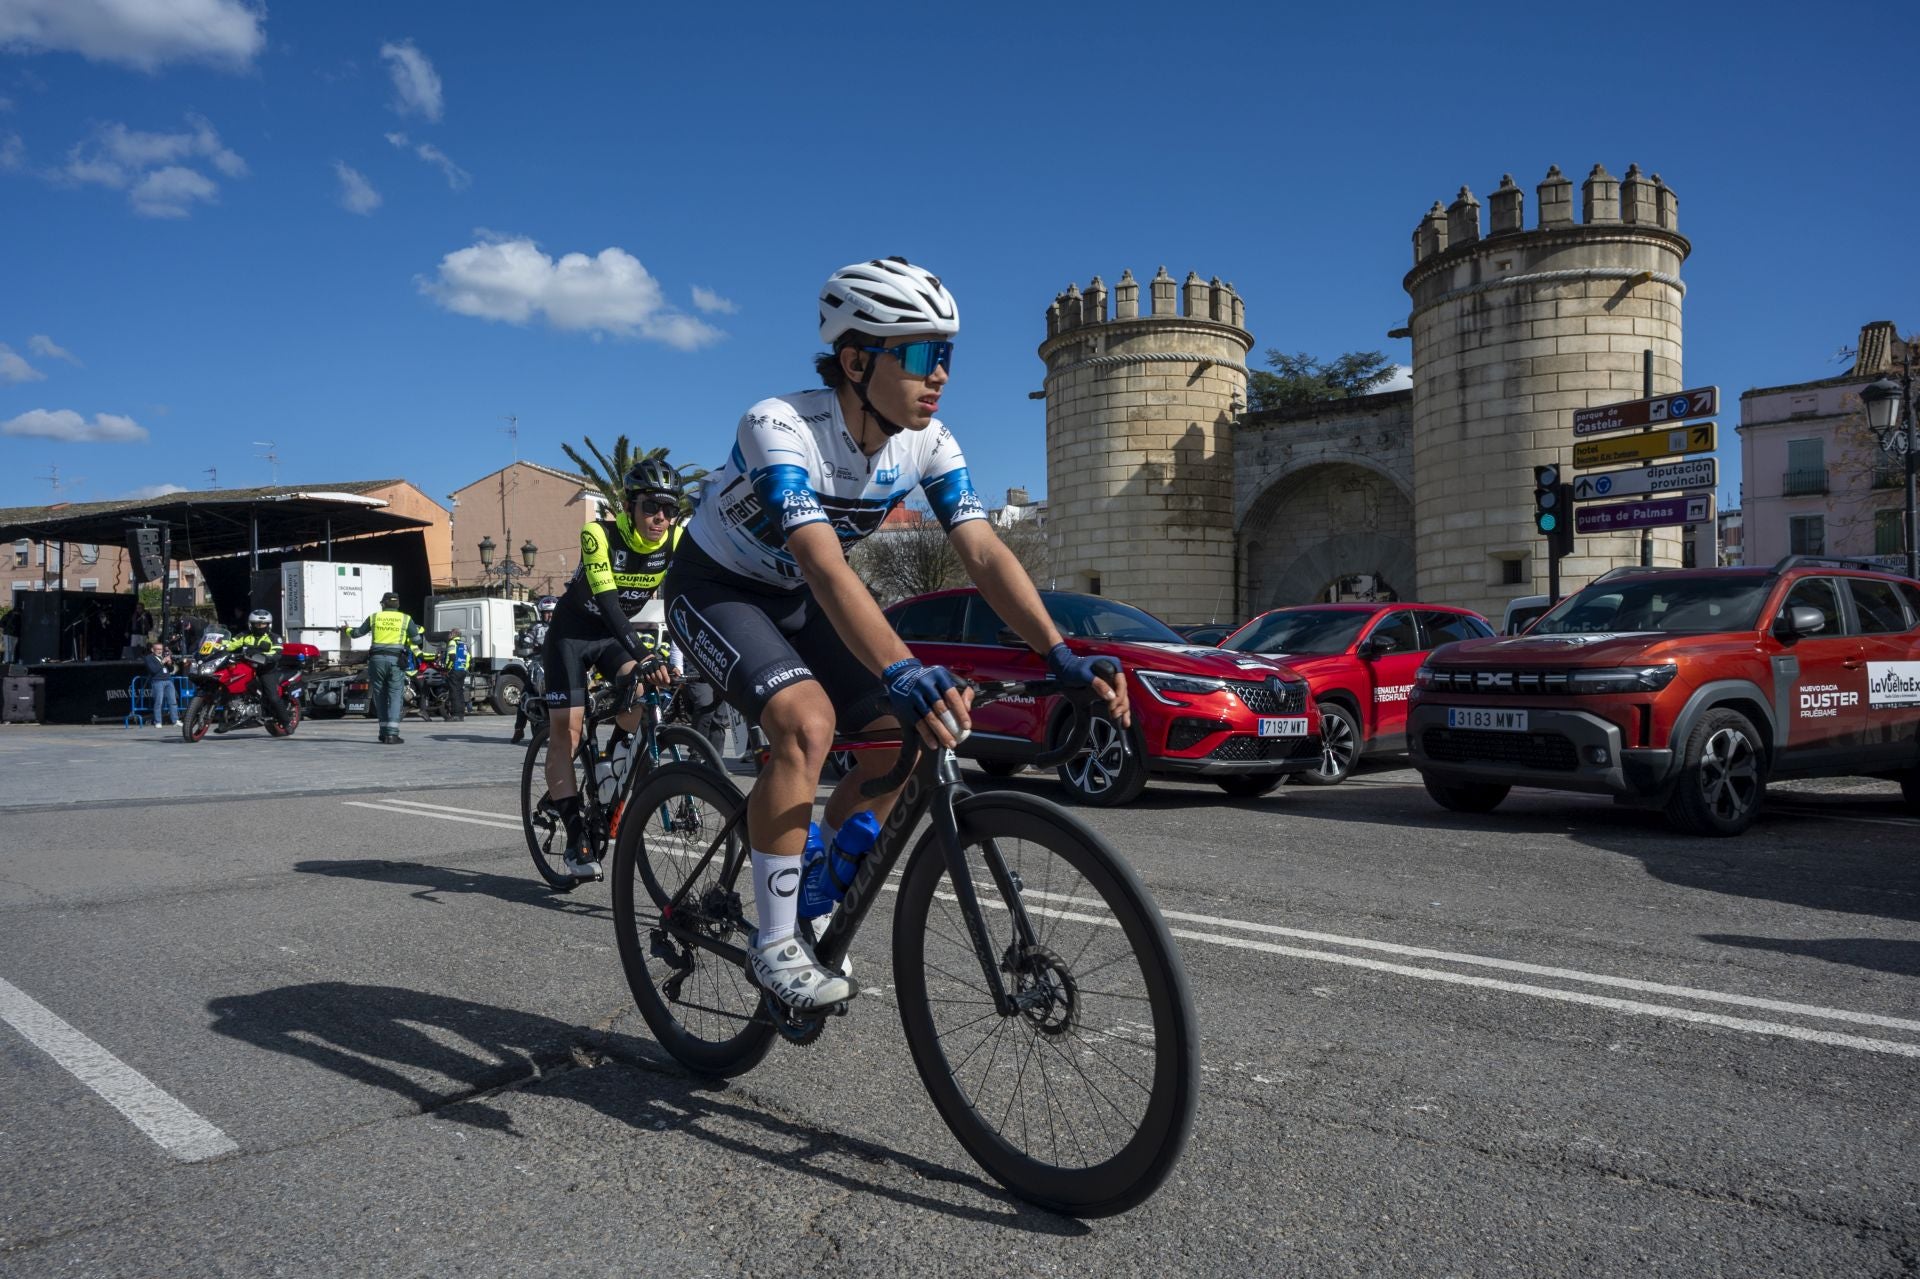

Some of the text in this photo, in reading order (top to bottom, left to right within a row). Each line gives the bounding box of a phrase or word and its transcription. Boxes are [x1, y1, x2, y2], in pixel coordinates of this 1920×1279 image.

[1577, 408, 1618, 422] parque de
[1577, 419, 1623, 433] Castelar
[1577, 445, 1598, 456] hotel
[1651, 473, 1711, 490] provincial
[1579, 506, 1674, 525] puerta de Palmas
[696, 630, 728, 668] Ricardo
[694, 642, 724, 681] Fuentes
[1374, 684, 1415, 695] RENAULT AUST
[1871, 676, 1920, 693] LaVueltaEx
[1394, 692, 1407, 701] FULL
[1800, 691, 1859, 709] DUSTER
[1457, 712, 1524, 728] 3183 MWT
[1800, 709, 1837, 718] PRUÉBAME
[1264, 720, 1306, 734] 7197 MWT
[833, 774, 919, 935] COLNAGO
